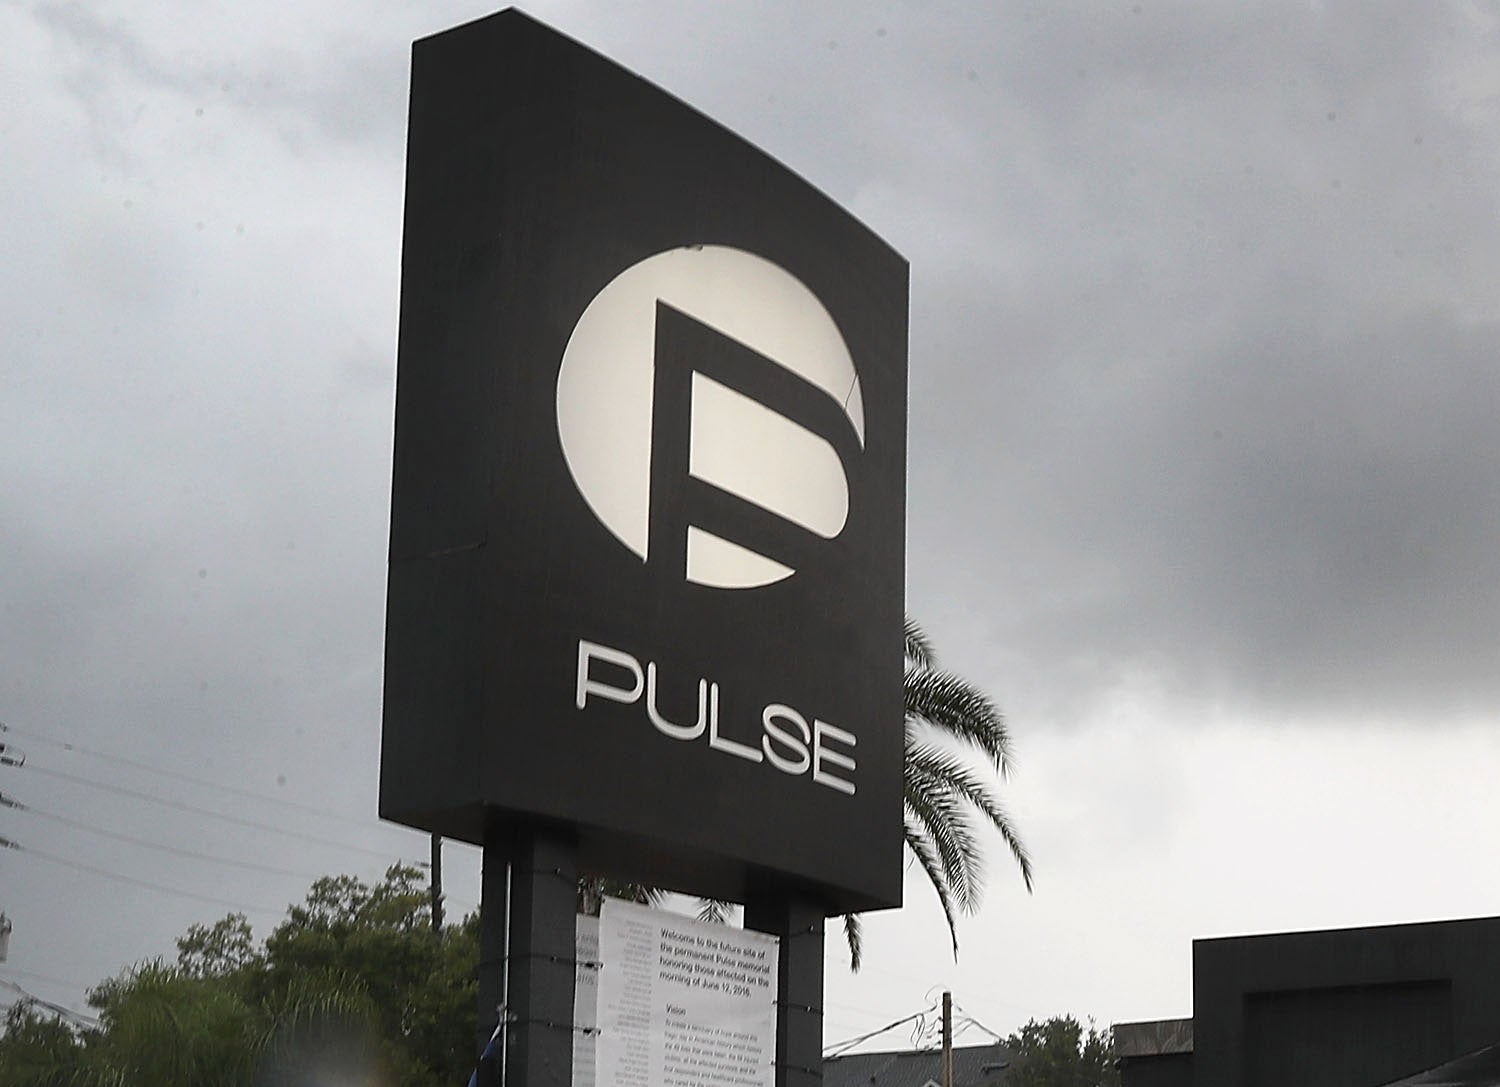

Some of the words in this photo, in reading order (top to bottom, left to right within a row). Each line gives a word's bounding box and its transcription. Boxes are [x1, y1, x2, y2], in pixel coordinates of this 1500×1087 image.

[575, 639, 857, 795] PULSE
[660, 942, 672, 952] the
[674, 947, 714, 960] permanent
[716, 954, 736, 966] Pulse
[737, 961, 769, 974] memorial
[661, 928, 694, 944] Welcome
[697, 936, 704, 946] to
[707, 939, 718, 949] the
[720, 942, 740, 953] future
[743, 949, 755, 958] site
[758, 951, 765, 959] of
[660, 956, 692, 973] honoring
[695, 964, 714, 975] those
[716, 969, 745, 981] affected
[758, 978, 769, 987] the
[660, 971, 690, 986] morning
[702, 980, 719, 990] June
